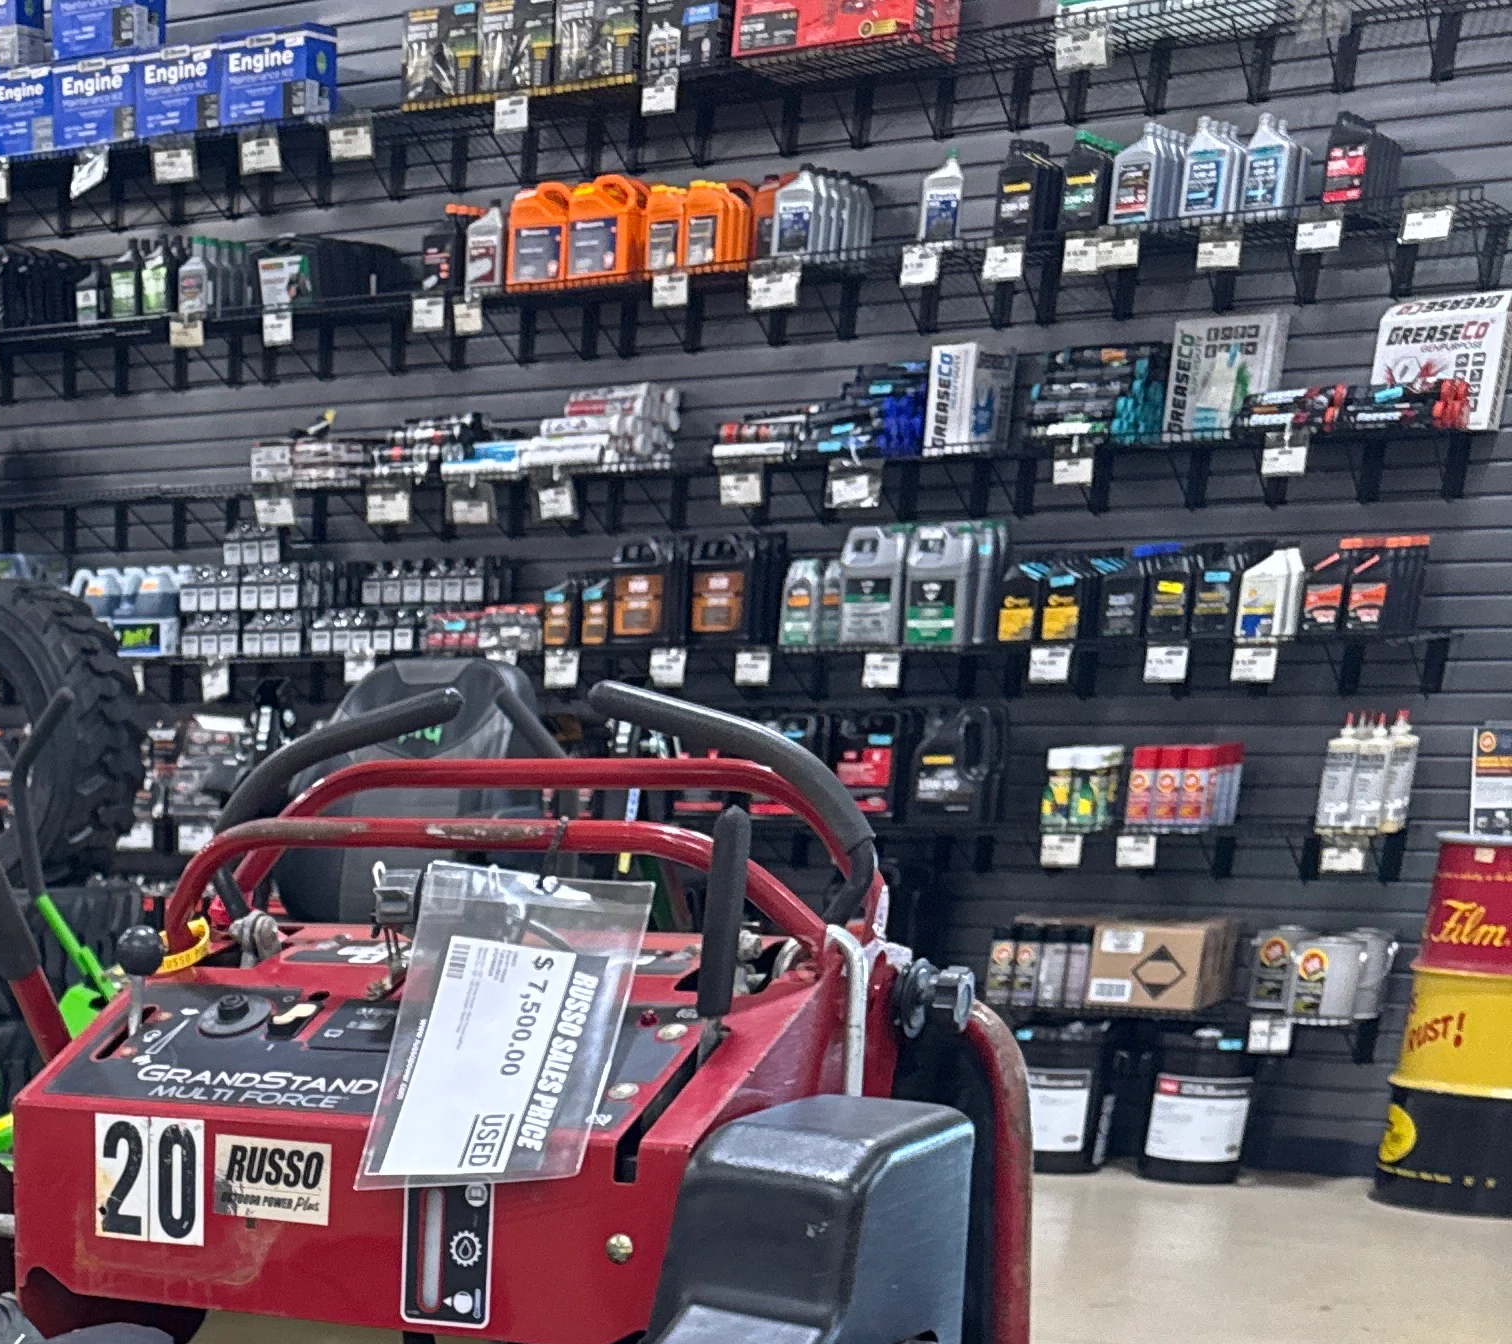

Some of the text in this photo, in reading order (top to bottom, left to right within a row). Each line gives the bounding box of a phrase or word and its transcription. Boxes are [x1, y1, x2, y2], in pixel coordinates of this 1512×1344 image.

[144, 59, 208, 85] Engine
[228, 48, 295, 74] Engine
[61, 73, 123, 97] Engine
[532, 956, 555, 971] $
[499, 979, 549, 1077] 7,500.00
[517, 970, 598, 1152] RUSSO SALES PRICE
[148, 1084, 344, 1108] MULTI FORCE
[466, 1113, 506, 1168] USED
[100, 1120, 196, 1239] 20
[226, 1144, 324, 1190] RUSSO
[294, 1195, 320, 1212] Plus
